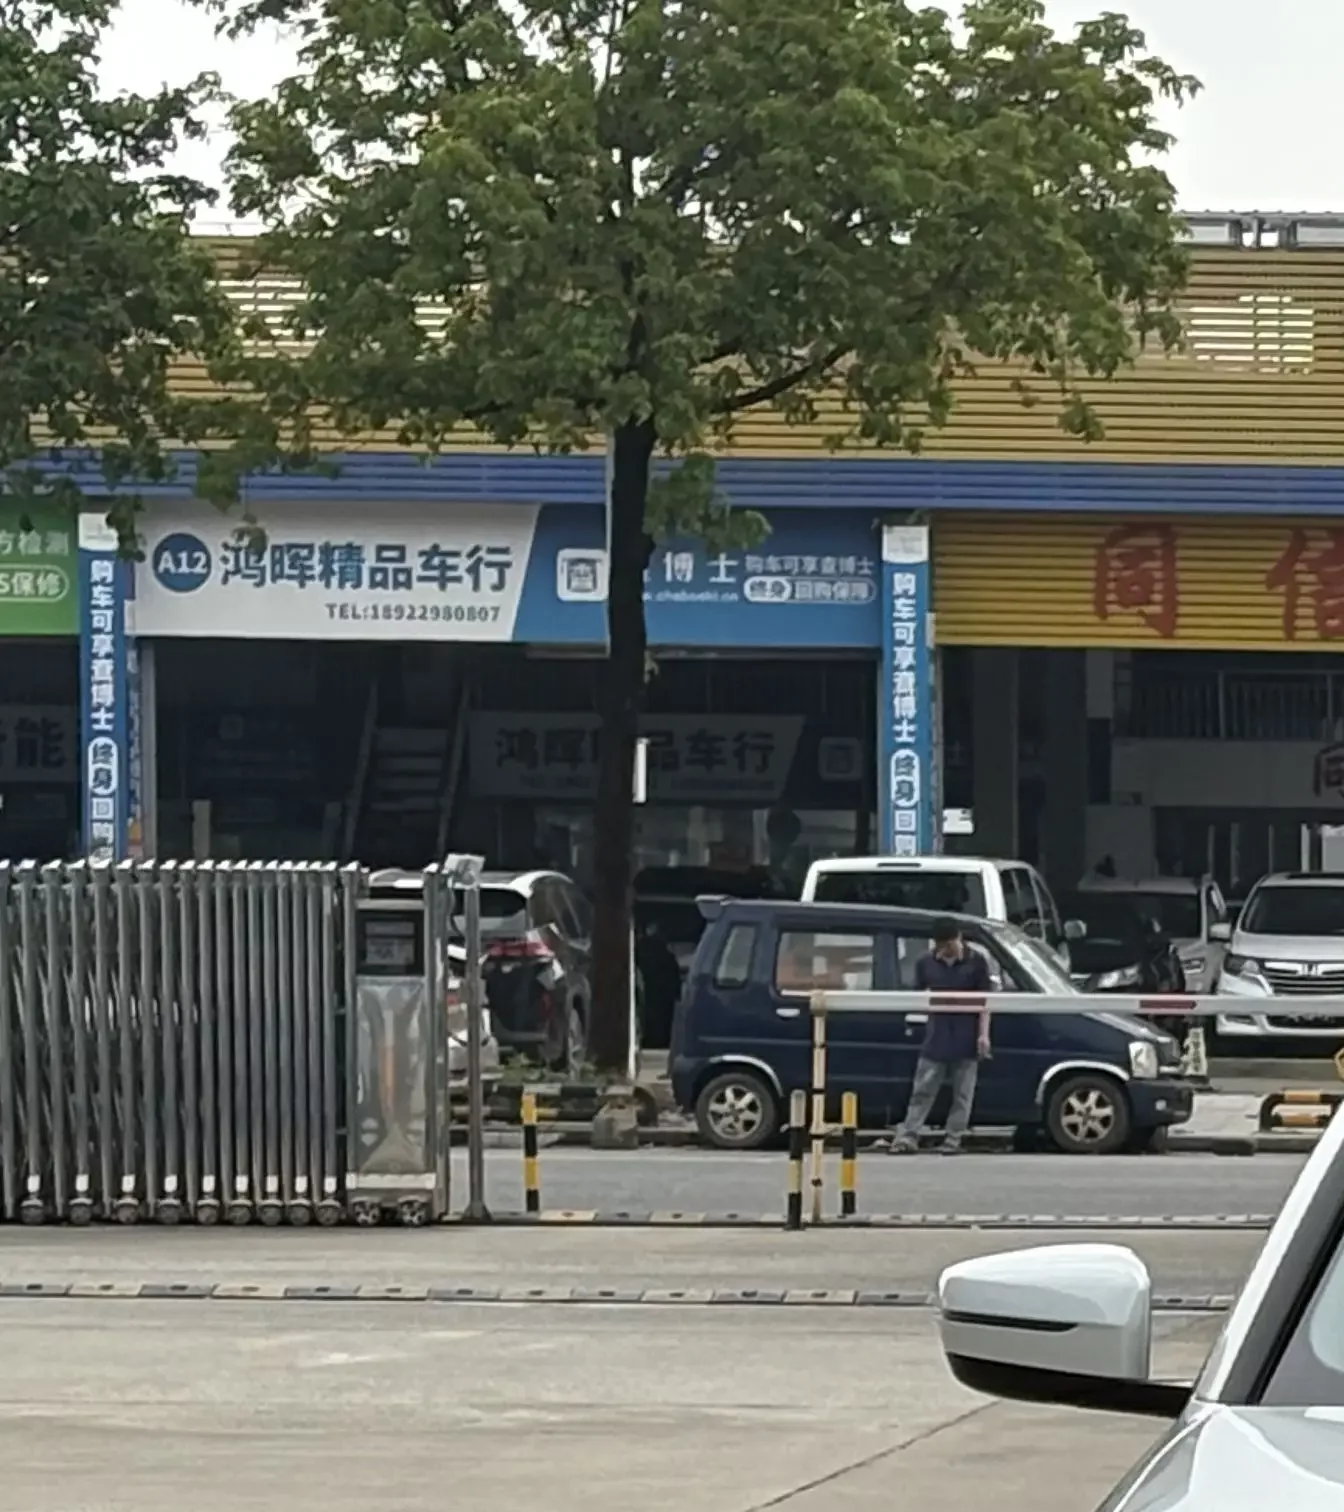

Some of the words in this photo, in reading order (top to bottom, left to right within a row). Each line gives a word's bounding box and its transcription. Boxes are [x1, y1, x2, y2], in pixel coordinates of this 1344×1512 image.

[158, 551, 208, 574] A12
[220, 542, 512, 592] 鸿晖精品车行
